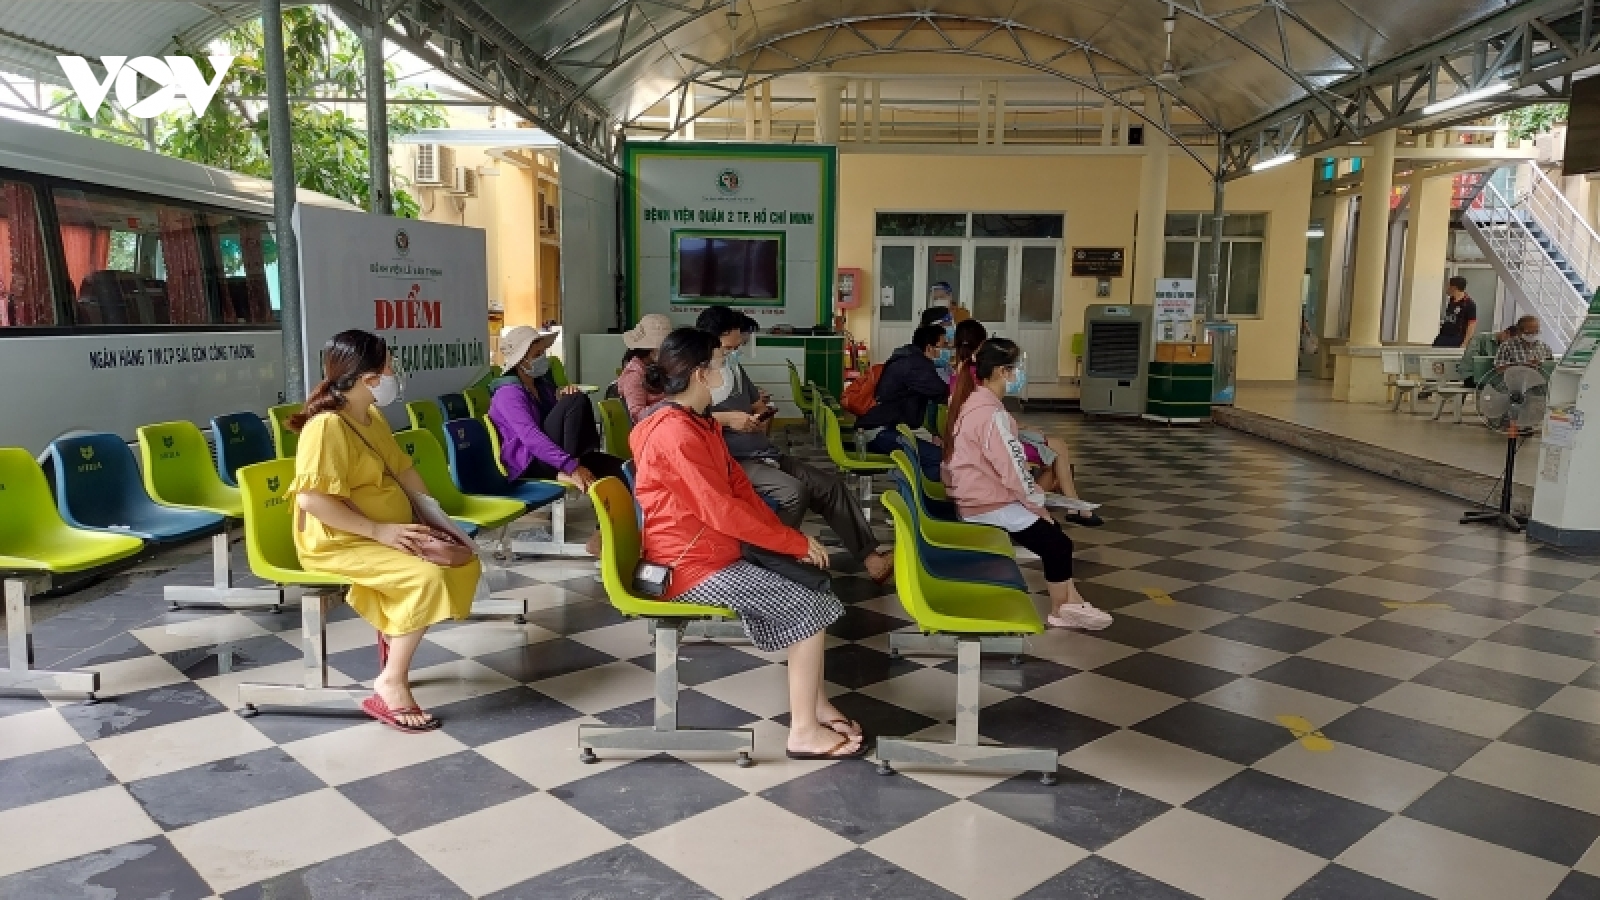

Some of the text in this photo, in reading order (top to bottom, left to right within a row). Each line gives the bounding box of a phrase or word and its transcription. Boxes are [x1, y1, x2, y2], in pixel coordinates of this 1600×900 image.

[644, 206, 815, 226] BỆNH VIỆN QUẬN 2 TP. HỒ CHÍ MINH
[373, 283, 443, 331] ĐIỂM
[89, 346, 117, 370] NGÂN
[118, 346, 145, 367] HÀNG
